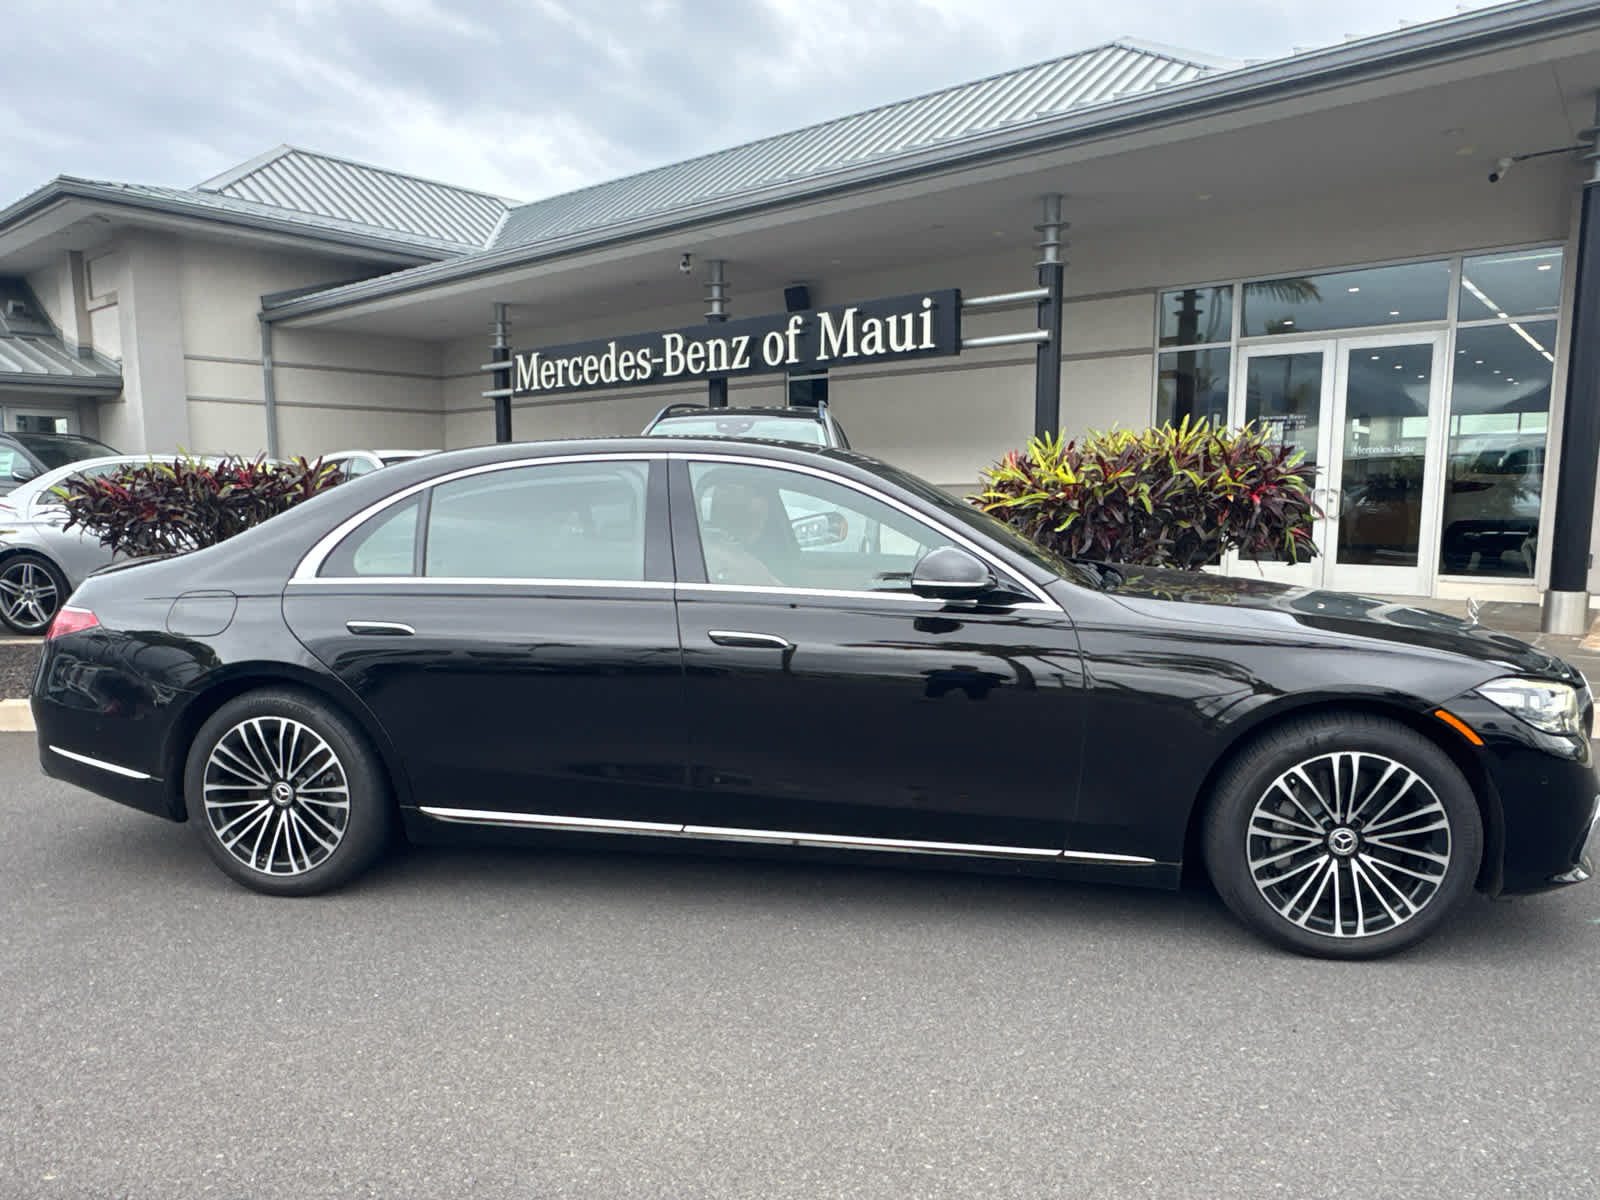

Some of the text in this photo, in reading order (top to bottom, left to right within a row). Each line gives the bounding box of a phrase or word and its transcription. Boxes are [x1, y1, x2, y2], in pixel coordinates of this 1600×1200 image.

[514, 297, 936, 392] Mercedes-Benz of Maui
